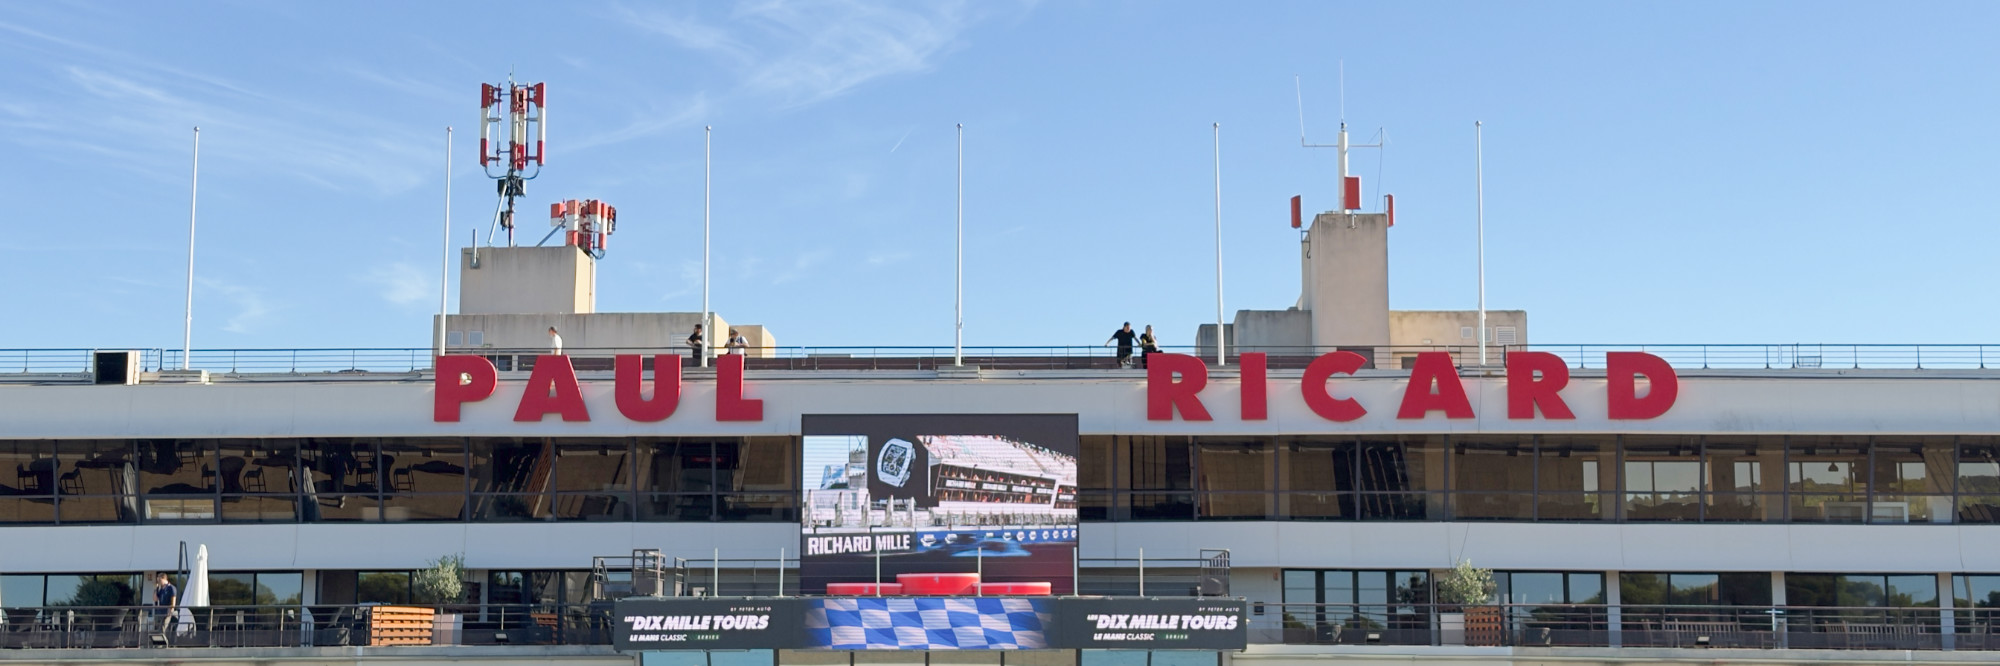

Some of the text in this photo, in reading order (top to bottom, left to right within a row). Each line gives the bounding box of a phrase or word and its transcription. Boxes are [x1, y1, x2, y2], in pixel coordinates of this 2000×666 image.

[434, 350, 1678, 422] PAUL RICARD
[807, 534, 911, 556] RICHARD MILLE
[632, 616, 664, 631] DIX
[663, 616, 711, 631] MILLE
[713, 615, 770, 630] TOURS
[1096, 614, 1130, 630] DIX
[1128, 614, 1179, 630] MILLE
[1181, 615, 1239, 631] TOURS
[629, 634, 638, 642] LE
[638, 634, 660, 642] MANS
[660, 634, 687, 642] CLASSIC
[1093, 633, 1102, 641] LE
[1103, 633, 1126, 641] MANS
[1126, 633, 1155, 641] CLASSIC
